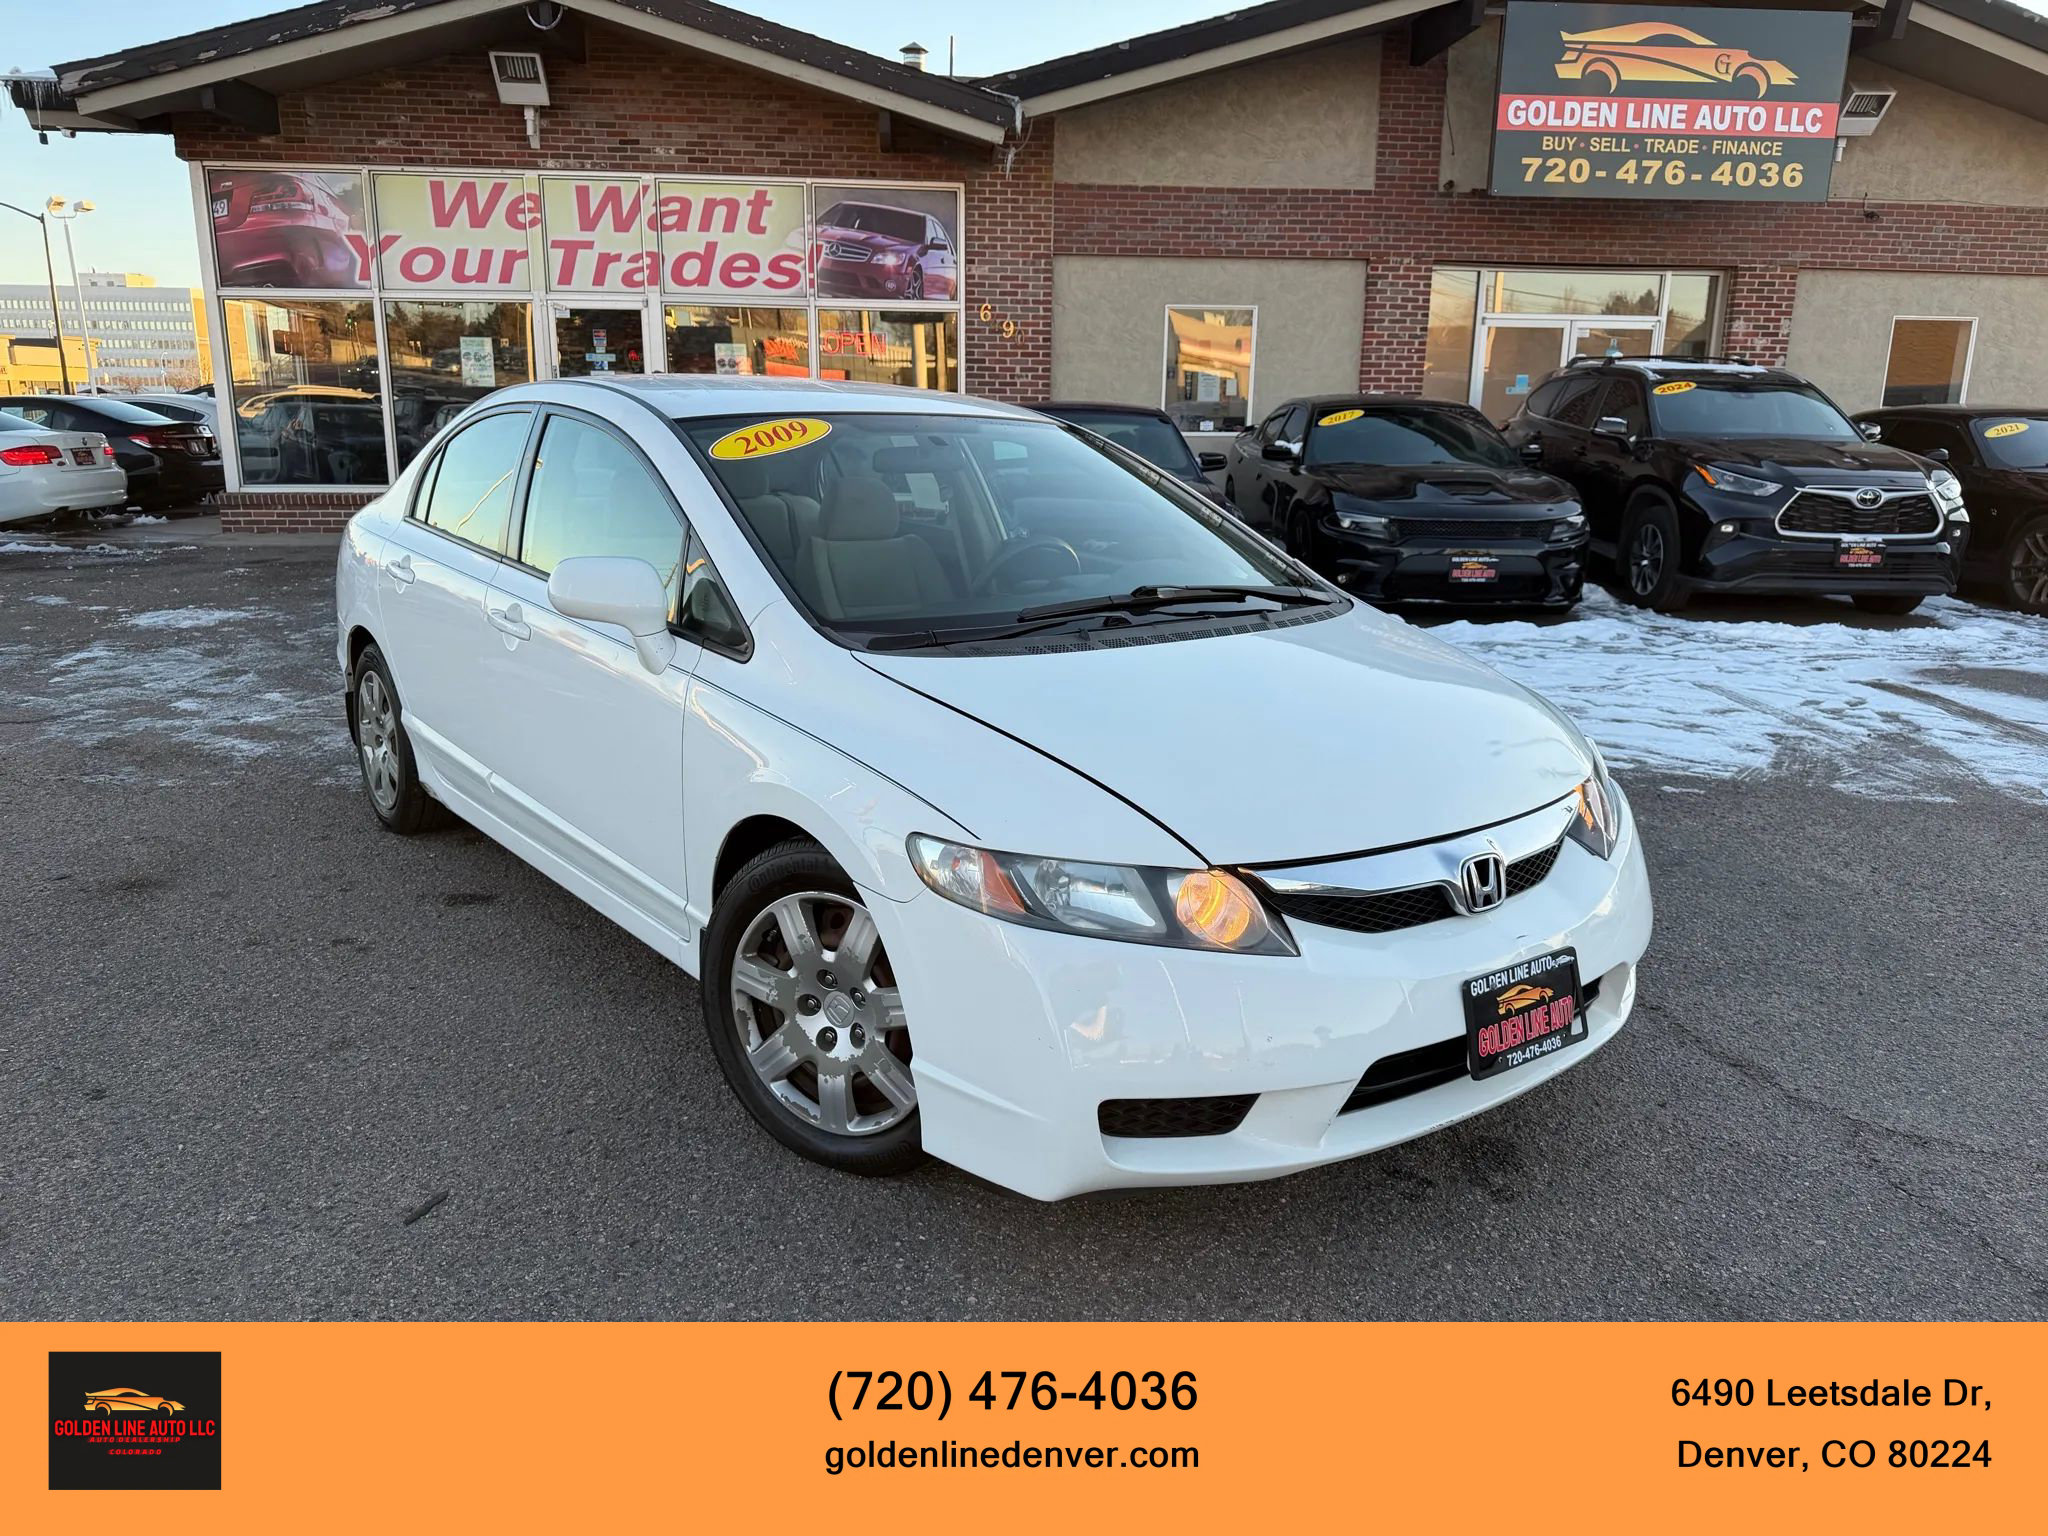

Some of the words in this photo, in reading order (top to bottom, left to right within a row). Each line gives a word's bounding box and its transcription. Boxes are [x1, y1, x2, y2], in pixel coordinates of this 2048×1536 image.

[1714, 53, 1731, 76] G
[1507, 99, 1617, 128] GOLDEN
[1625, 102, 1687, 130] LINE
[1693, 104, 1767, 132] AUTO
[1774, 106, 1824, 134] LLC
[1542, 136, 1577, 152] BUY
[1589, 138, 1631, 153] SELL
[1644, 139, 1699, 154] TRADE
[1712, 140, 1783, 156] FINANCE
[429, 180, 542, 231] We
[574, 184, 773, 235] Want
[345, 234, 529, 284] Your
[550, 239, 824, 290] Trades!
[823, 331, 888, 356] OPEN
[1658, 382, 1692, 393] 2024
[1327, 411, 1354, 425] 2017
[1993, 423, 2021, 436] 2021
[734, 420, 808, 455] 2009
[1470, 970, 1508, 997] GOLDEN
[1508, 962, 1530, 984] LINE
[1530, 955, 1553, 977] AUTO
[1478, 1014, 1526, 1057] GOLDEN
[1524, 1005, 1550, 1041] LINE
[1549, 994, 1574, 1032] AUTO
[1507, 1035, 1562, 1067] 720-476-4036
